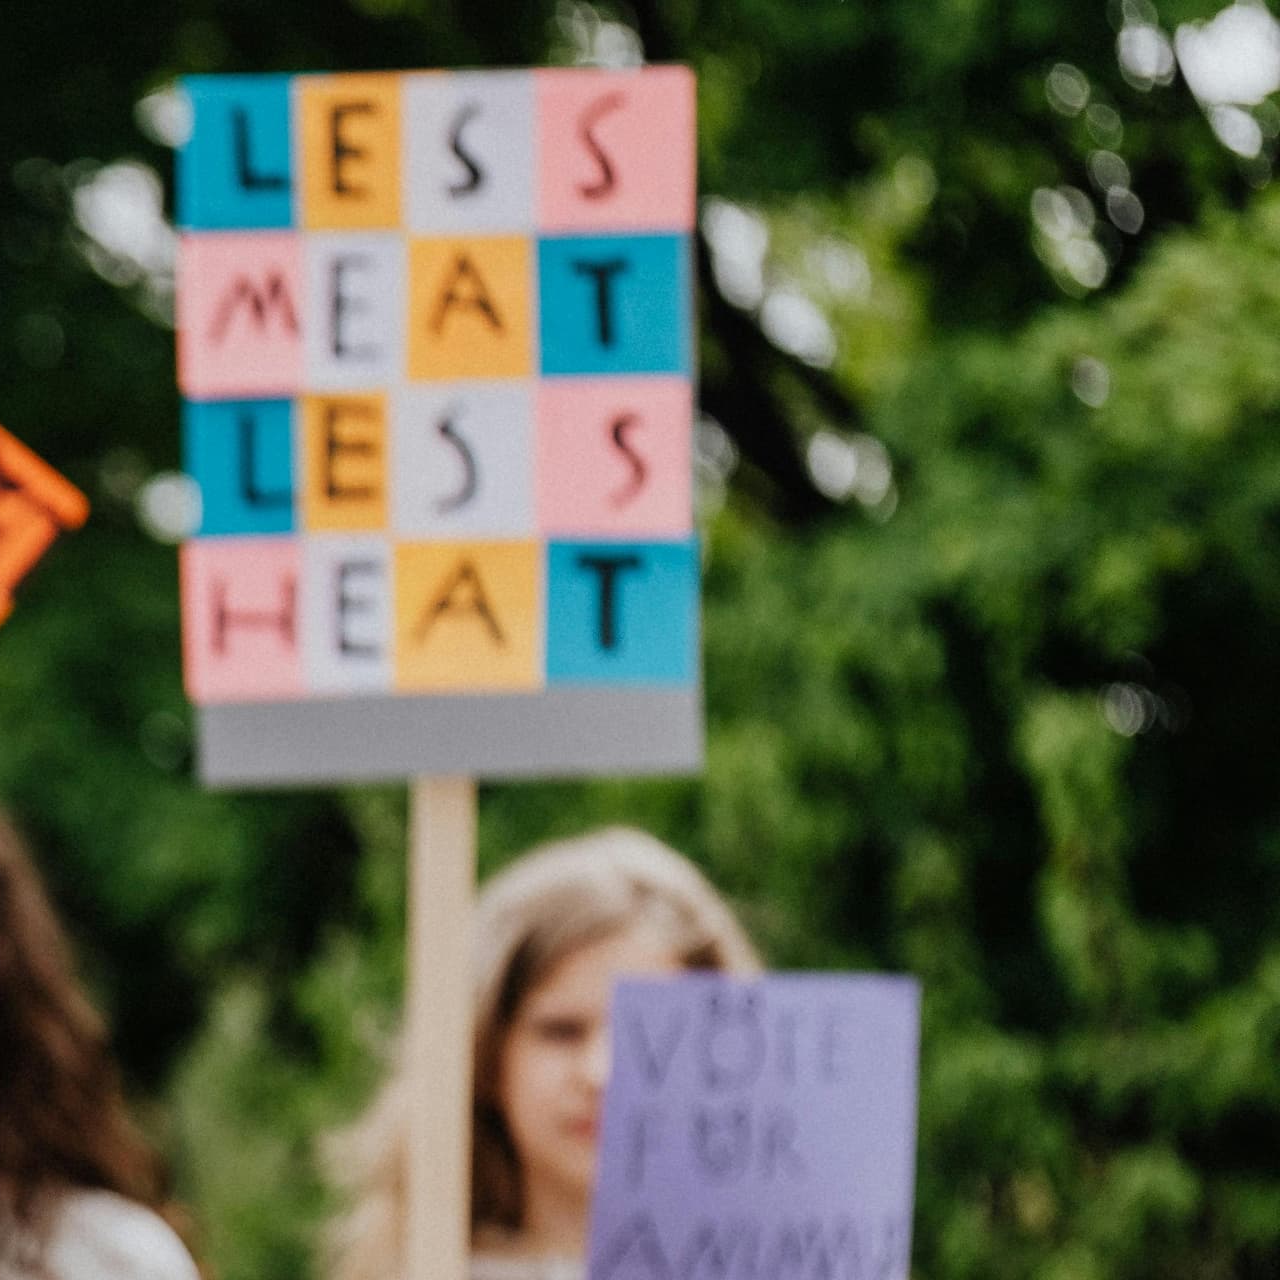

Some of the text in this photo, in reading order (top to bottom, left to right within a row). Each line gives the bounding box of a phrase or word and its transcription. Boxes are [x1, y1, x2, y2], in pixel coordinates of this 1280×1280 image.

[230, 92, 630, 200] LESS
[207, 249, 634, 362] MEAT
[241, 402, 651, 516] LESS
[209, 552, 646, 660] HEAT
